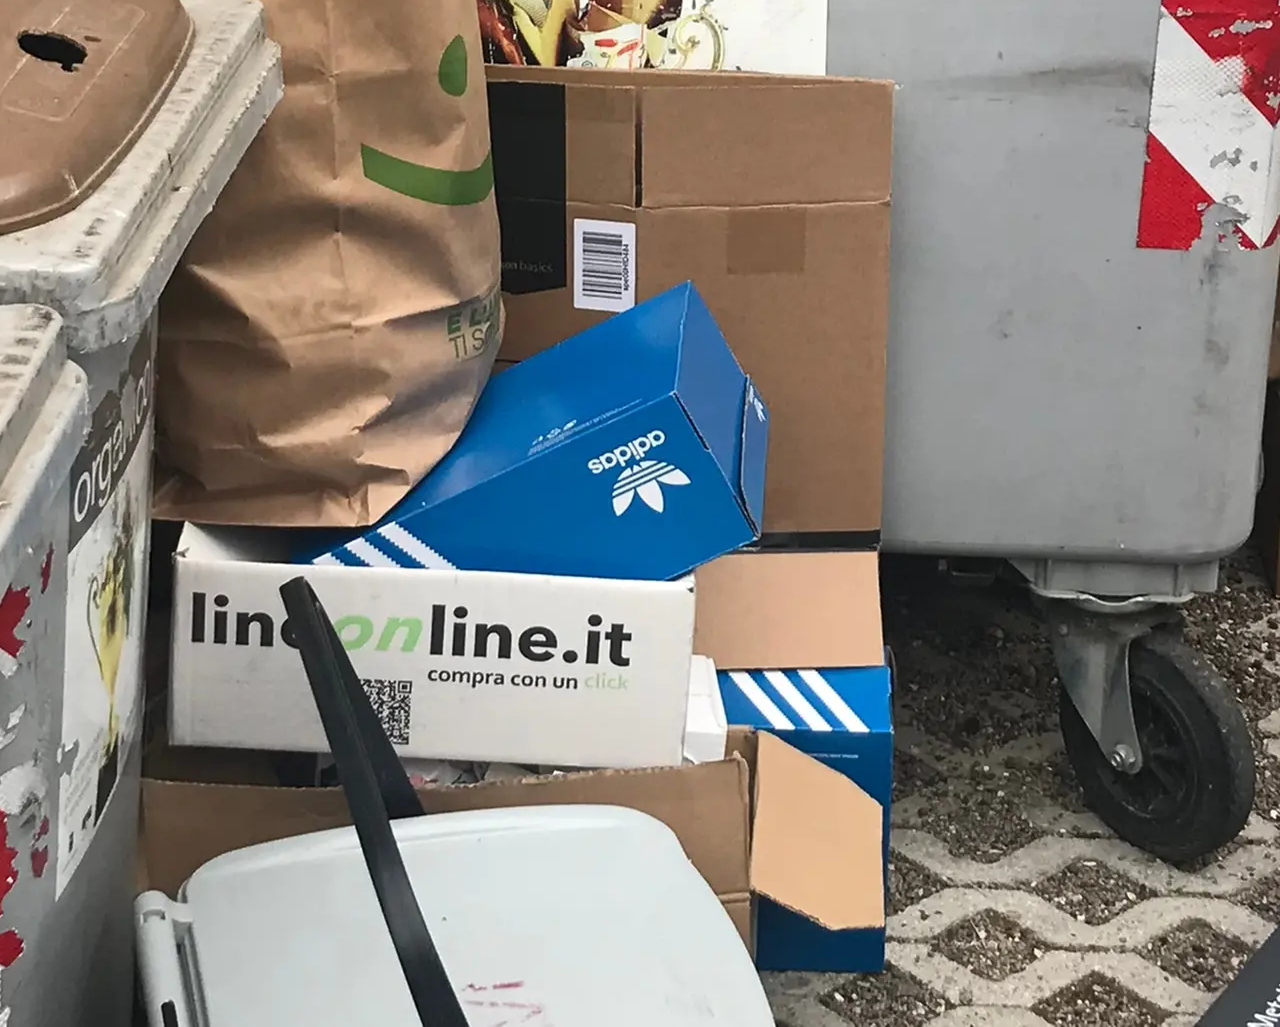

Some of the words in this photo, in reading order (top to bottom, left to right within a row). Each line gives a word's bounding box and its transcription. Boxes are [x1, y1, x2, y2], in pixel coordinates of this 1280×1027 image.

[587, 430, 666, 475] adidas
[426, 667, 505, 688] compra
[509, 672, 547, 688] con
[551, 673, 578, 690] un
[583, 671, 629, 691] click
